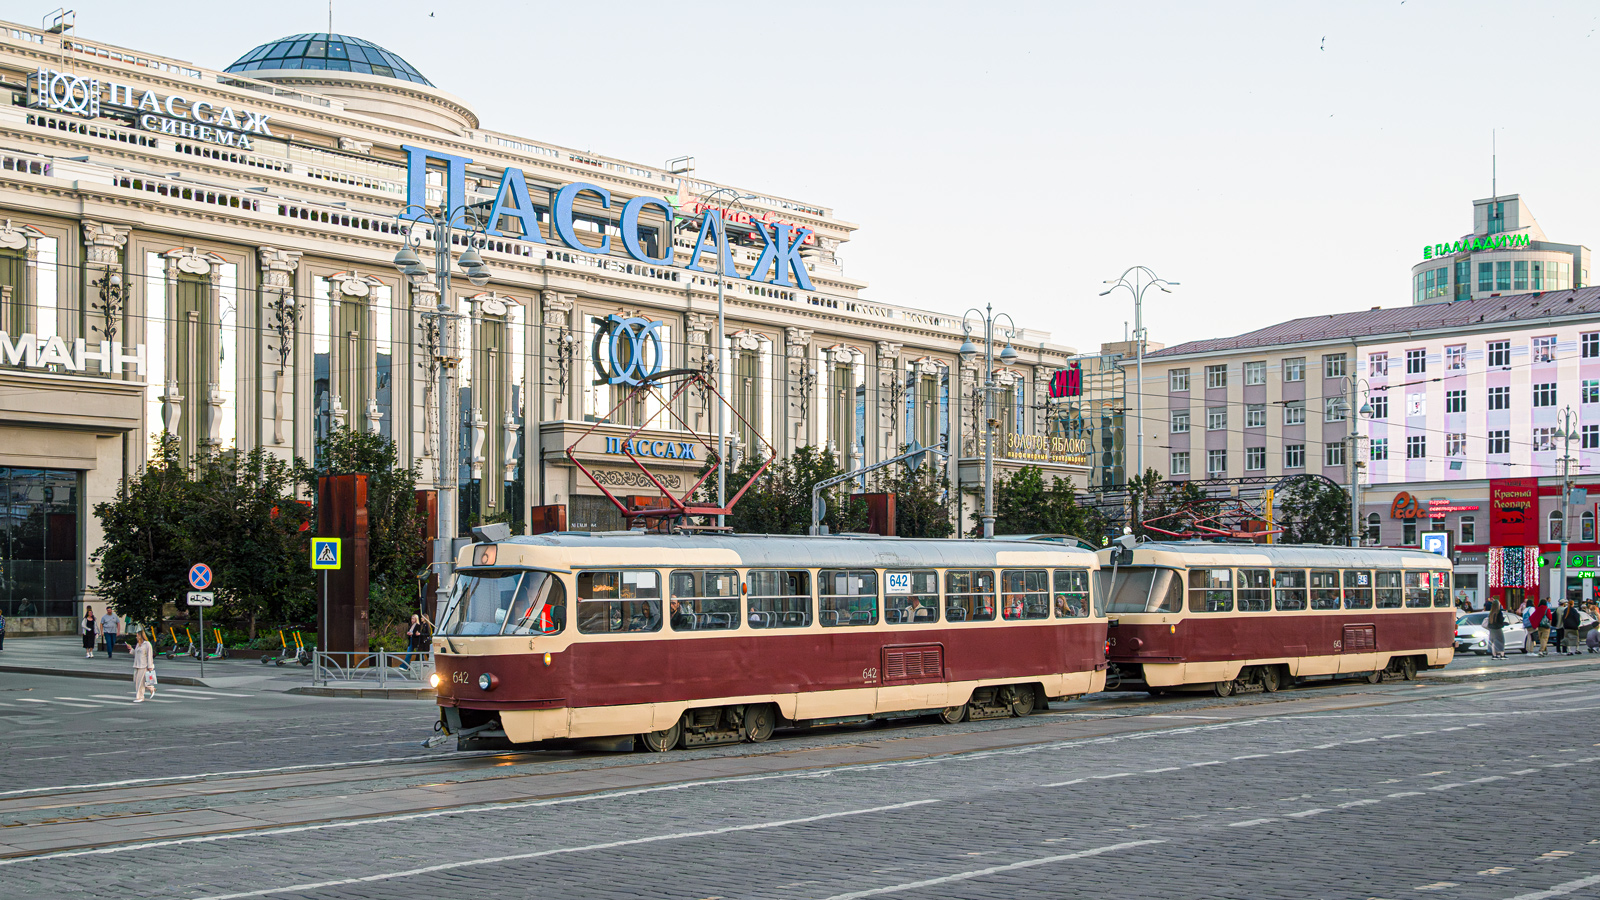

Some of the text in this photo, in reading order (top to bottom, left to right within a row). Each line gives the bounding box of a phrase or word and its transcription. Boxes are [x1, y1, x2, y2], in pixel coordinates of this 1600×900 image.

[108, 81, 273, 136] ПАССАЖ
[141, 114, 252, 150] СИНЕМА
[399, 143, 816, 291] ПАССАЖ
[1434, 233, 1531, 256] ПАЛЛАДИУМ
[0, 330, 146, 376] МАНН
[606, 436, 696, 460] ПАССАЖ
[1007, 432, 1087, 454] ЗОЛОТОЕ ЯБЛОКО
[1390, 491, 1427, 519] Рада
[1494, 489, 1532, 499] Красный
[1494, 500, 1531, 509] Леопард
[889, 574, 908, 587] 642
[1333, 639, 1342, 649] 643
[452, 671, 469, 684] 642
[862, 667, 877, 679] 642
